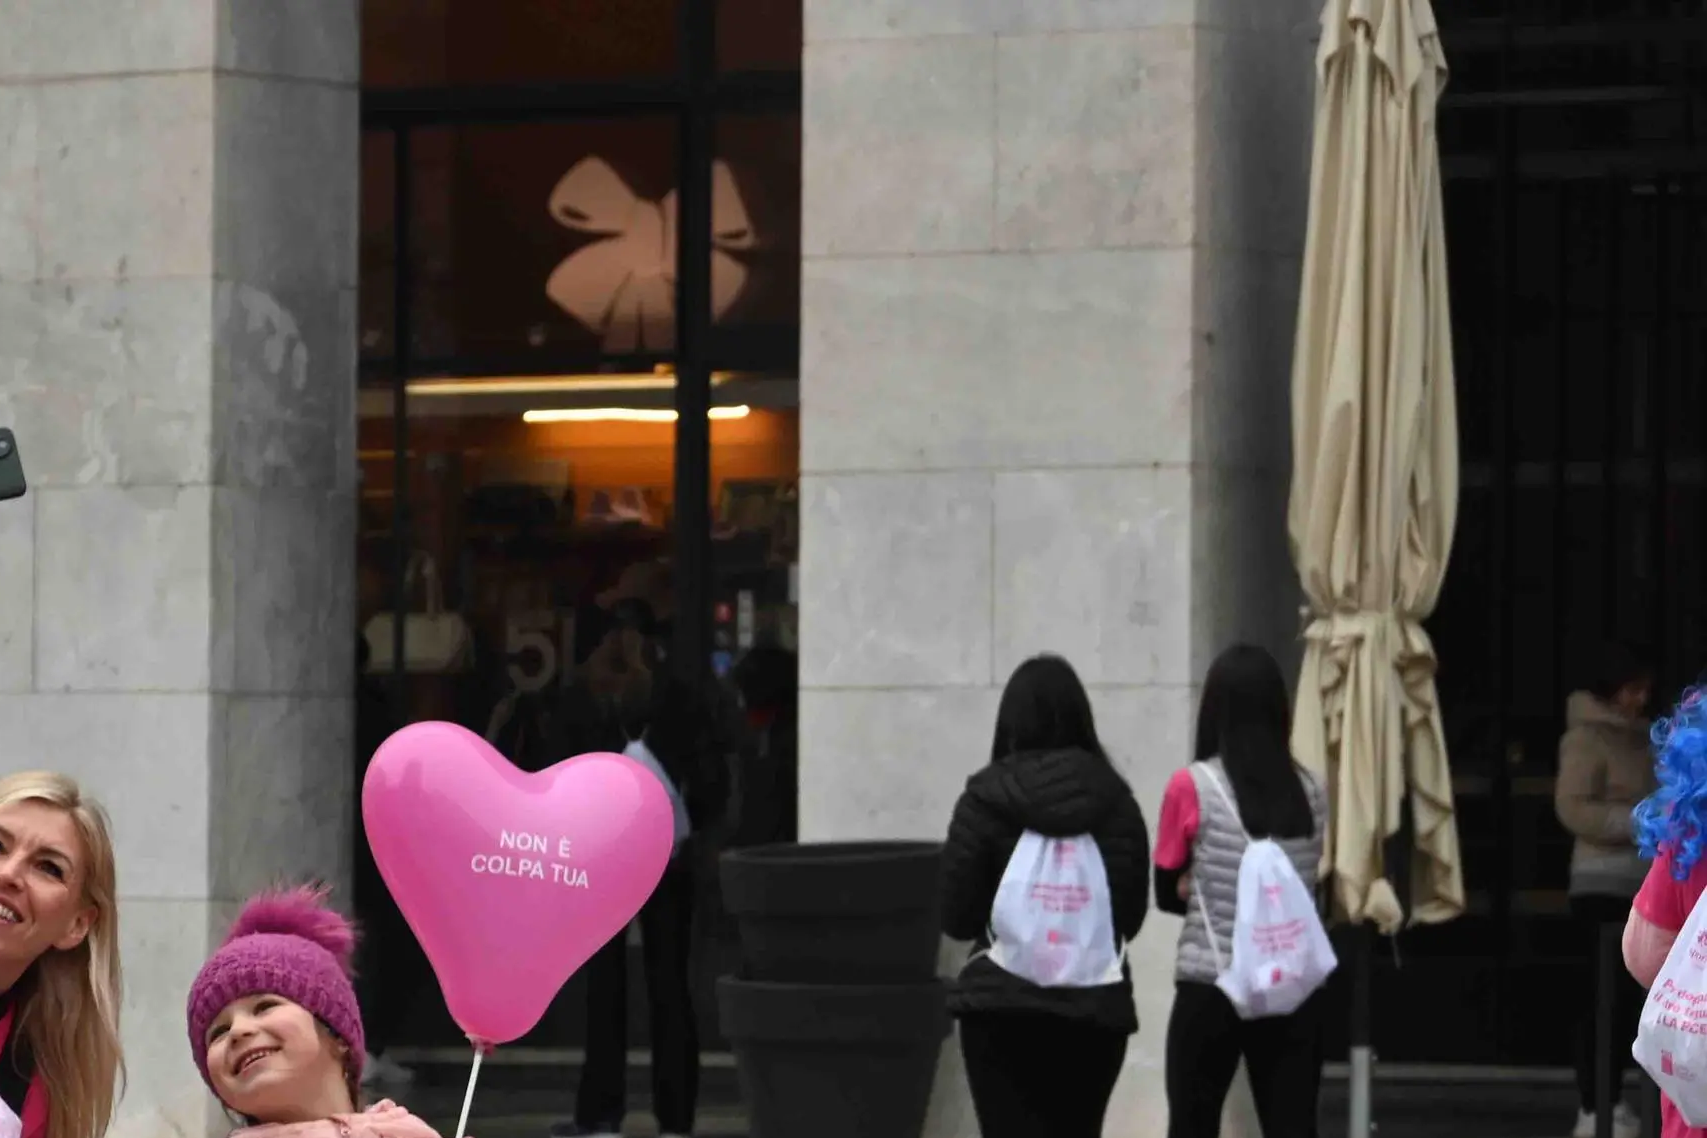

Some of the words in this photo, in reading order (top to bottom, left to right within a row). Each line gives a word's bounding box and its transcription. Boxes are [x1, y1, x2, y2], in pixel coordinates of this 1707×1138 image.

[499, 829, 547, 854] NON
[558, 836, 572, 858] È
[471, 853, 544, 880] COLPA
[550, 861, 589, 889] TUA
